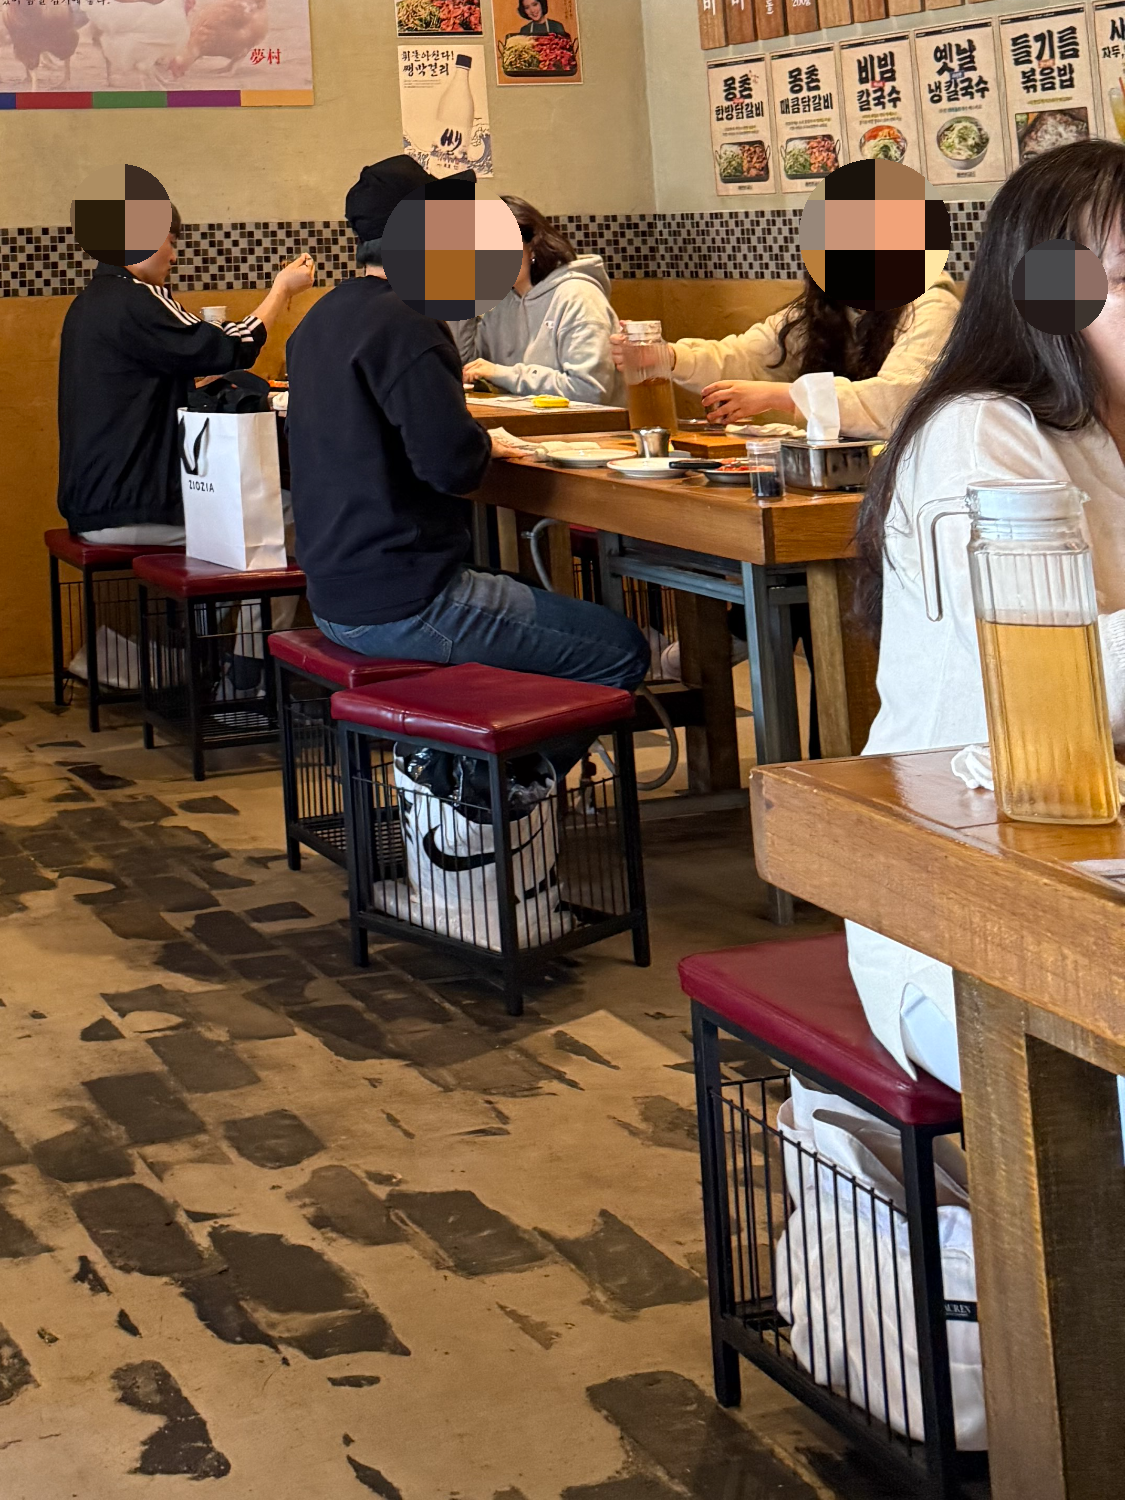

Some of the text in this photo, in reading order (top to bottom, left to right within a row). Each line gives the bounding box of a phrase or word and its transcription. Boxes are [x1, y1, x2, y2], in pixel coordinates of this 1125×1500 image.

[249, 48, 282, 65] 夢村
[933, 39, 977, 77] 옛날
[1010, 25, 1080, 66] 들기름
[788, 64, 821, 94] 몽촌
[856, 51, 897, 85] 비빔
[1021, 63, 1075, 94] 볶음밥
[723, 74, 753, 102] 몽촌
[856, 86, 902, 112] 칼국수
[927, 75, 990, 104] 냉칼국수
[715, 101, 764, 122] 한방닭갈비
[779, 92, 834, 115] 매콤닭갈비
[188, 479, 215, 493] ZIOZIA
